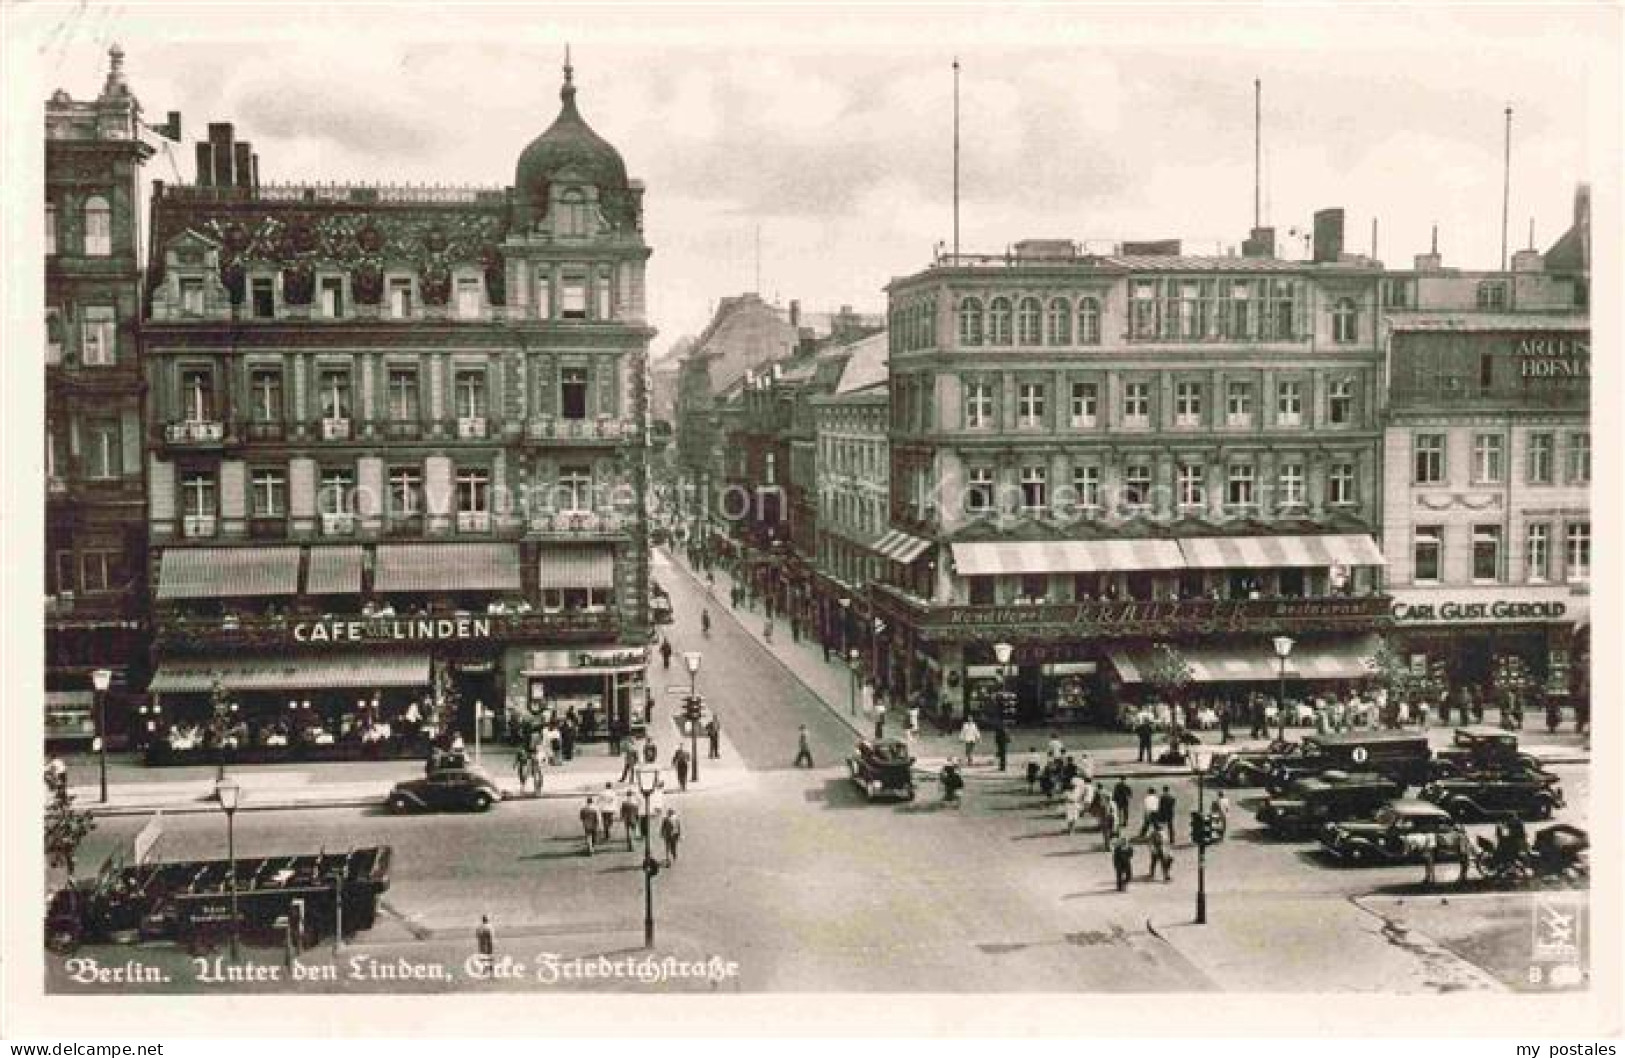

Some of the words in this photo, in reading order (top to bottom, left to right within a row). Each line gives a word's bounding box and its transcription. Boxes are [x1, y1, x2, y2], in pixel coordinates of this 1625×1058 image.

[1492, 601, 1567, 618] GEROLD
[294, 621, 362, 642] CAFE
[394, 619, 490, 639] LINDEN
